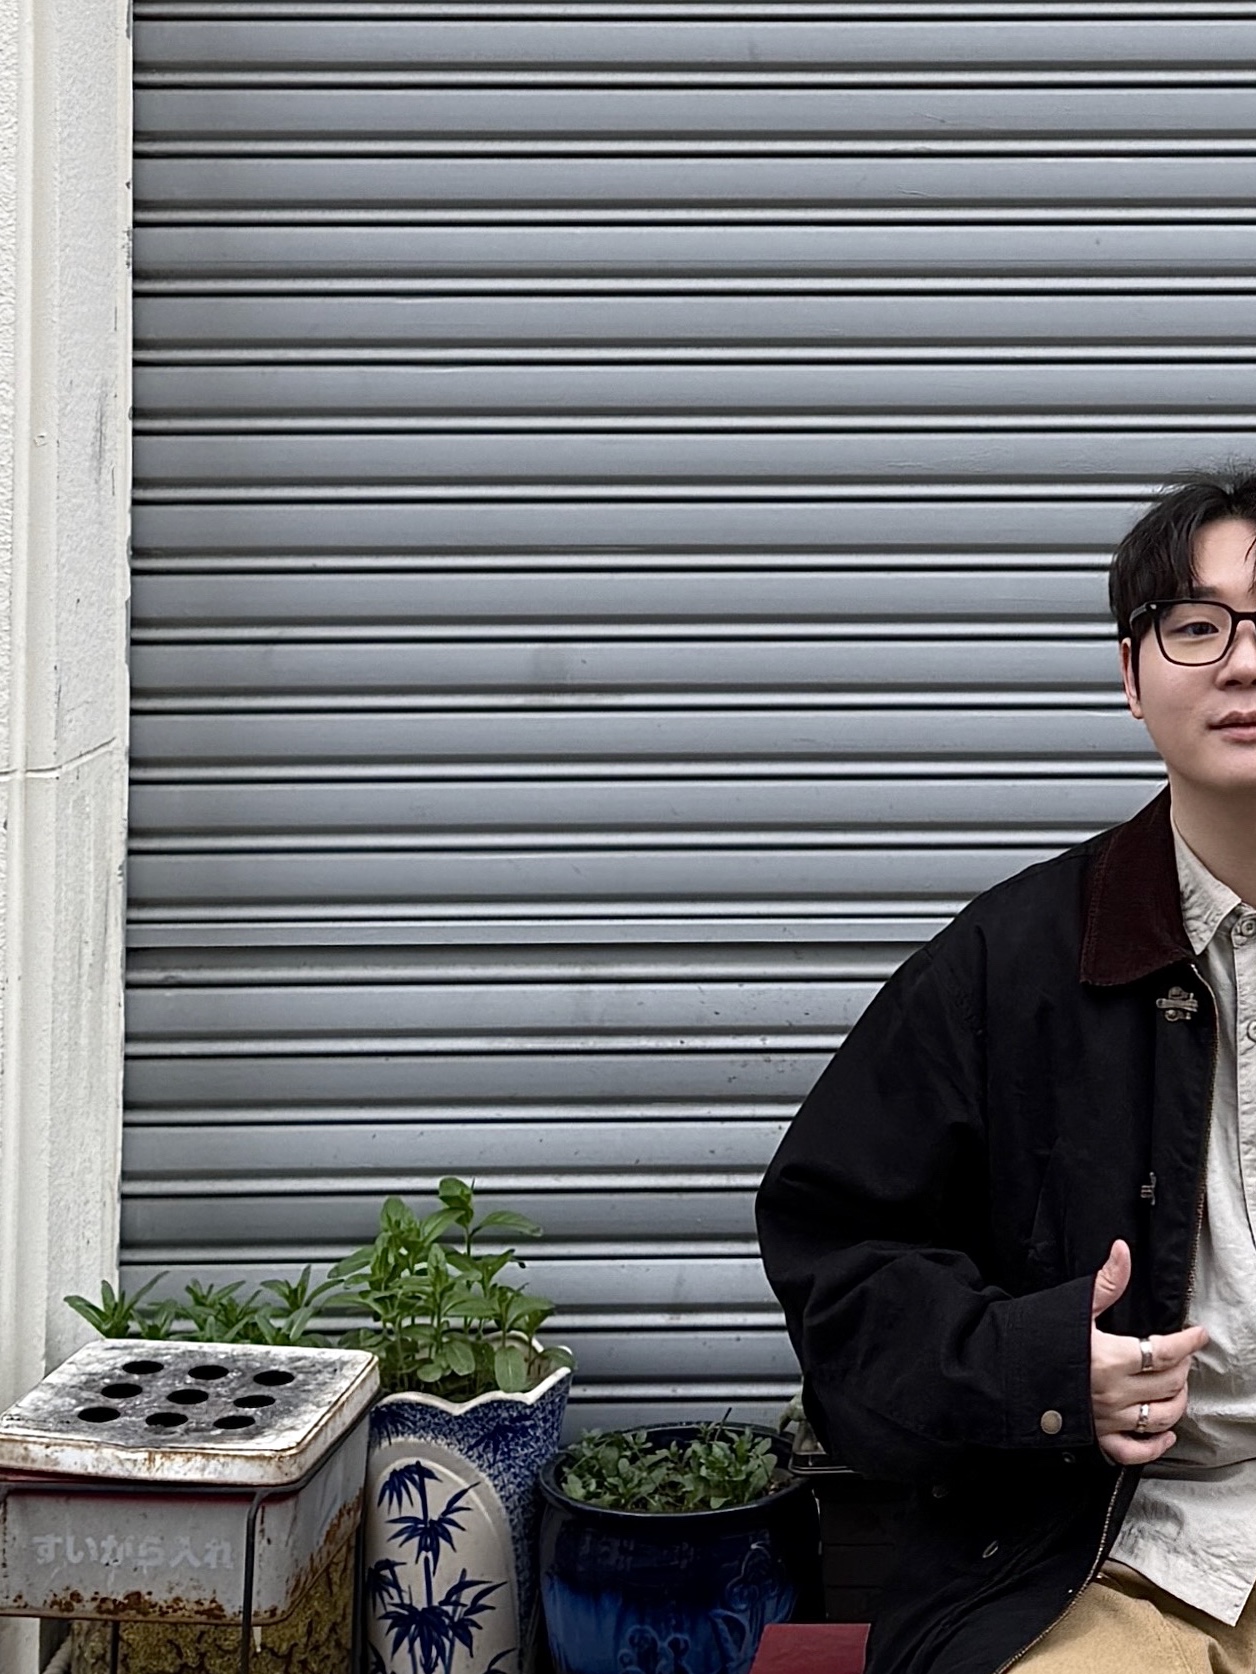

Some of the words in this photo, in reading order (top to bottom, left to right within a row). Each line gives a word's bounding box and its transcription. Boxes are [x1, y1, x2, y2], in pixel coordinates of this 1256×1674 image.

[32, 1534, 234, 1570] すいがら入れ
